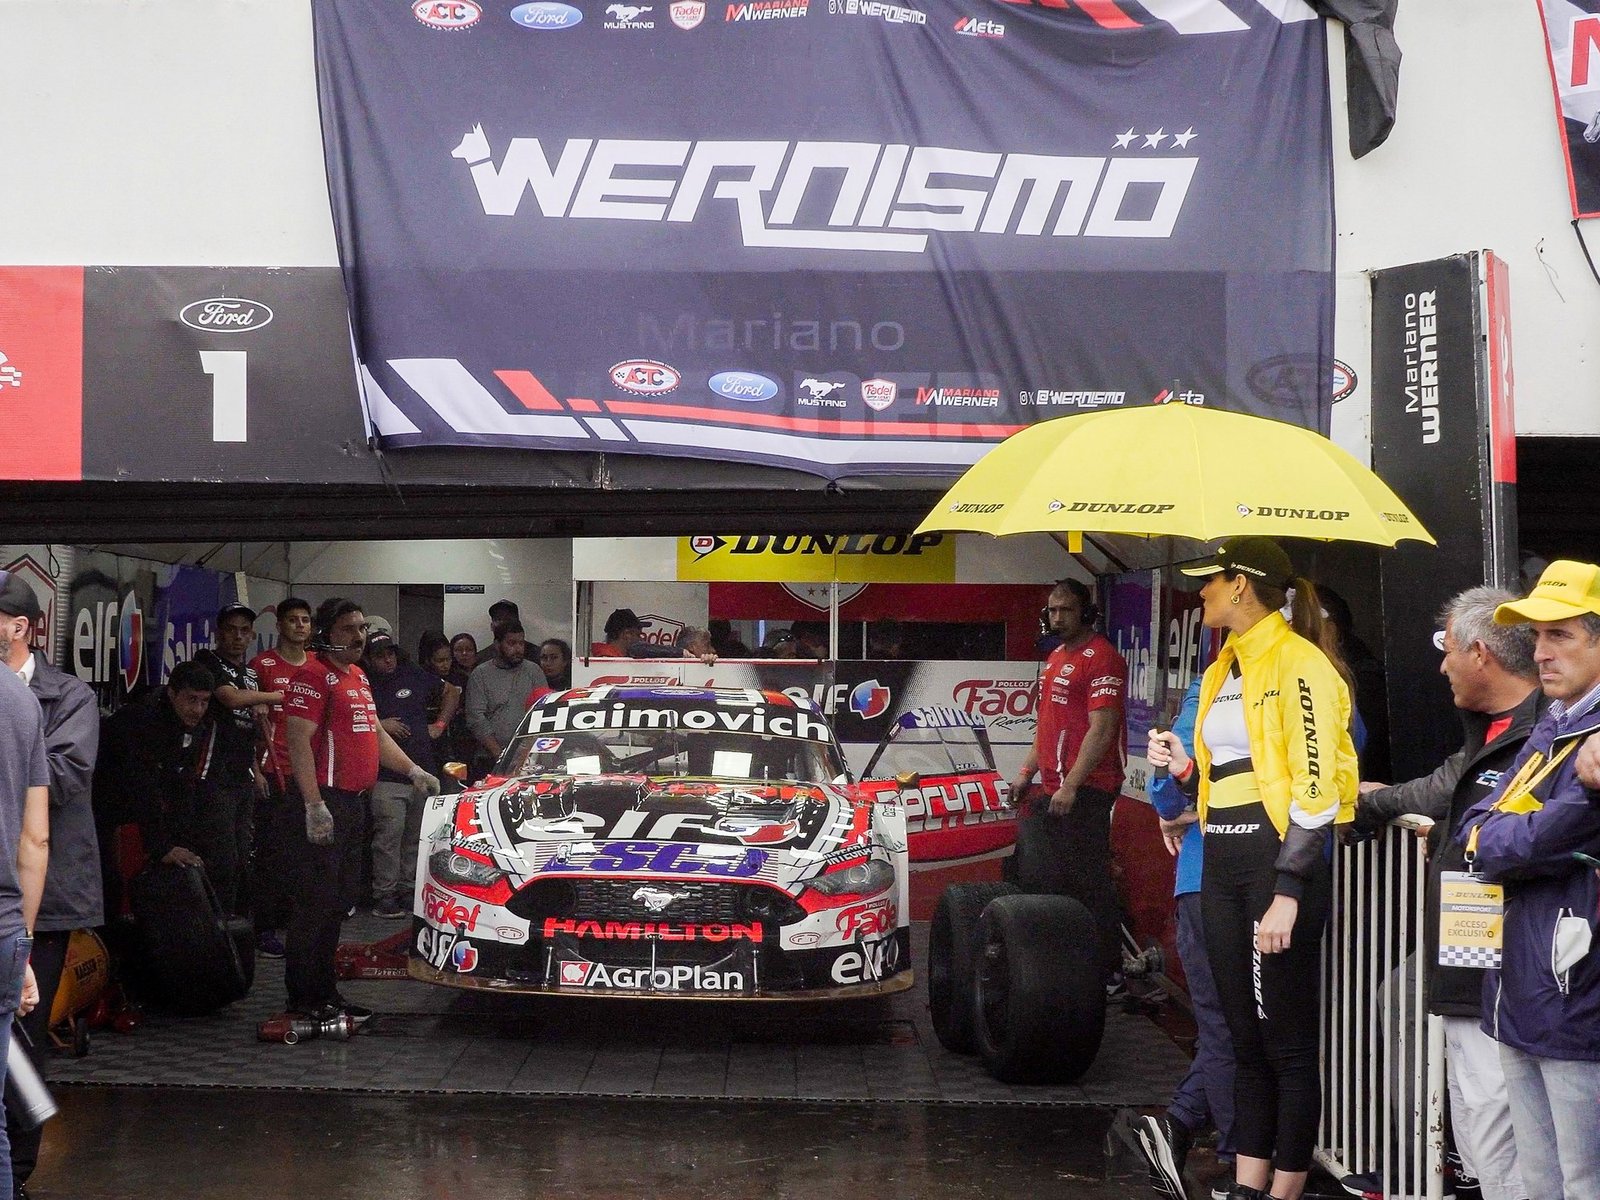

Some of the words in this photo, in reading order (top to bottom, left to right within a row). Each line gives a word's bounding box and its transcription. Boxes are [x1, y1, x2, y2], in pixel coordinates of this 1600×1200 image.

[523, 5, 567, 25] Ford
[673, 5, 703, 17] Fadel
[752, 7, 808, 20] WERNER
[954, 17, 1005, 35] Meta
[468, 137, 1199, 252] WERNISMO
[198, 302, 255, 327] Ford
[1404, 292, 1417, 414] Mariano
[1421, 289, 1441, 445] WERNER
[199, 351, 247, 442] 1
[721, 375, 765, 398] Ford
[864, 384, 893, 396] Fadel
[943, 387, 1000, 398] MARIANO
[797, 398, 847, 408] MUSTANG
[942, 397, 999, 408] WERNER
[958, 502, 1005, 514] DUNLOP
[1067, 501, 1175, 514] DUNLOP
[1256, 506, 1350, 521] DUNLOP
[729, 534, 944, 555] DUNLOP
[1235, 564, 1267, 577] DUNLOP
[73, 601, 118, 683] elf
[1168, 607, 1201, 690] elf
[293, 685, 322, 700] RODEO
[952, 680, 1040, 717] Fad
[527, 703, 830, 742] Haimovich
[1297, 677, 1321, 780] DUNLOP
[1455, 890, 1498, 900] DUNLOP
[543, 917, 764, 943] HAMILTON
[1447, 928, 1495, 939] EXCLUSIVO
[1454, 920, 1489, 930] ACCESO
[416, 926, 453, 967] elf
[831, 940, 888, 985] elf
[586, 962, 745, 991] AgroPlan
